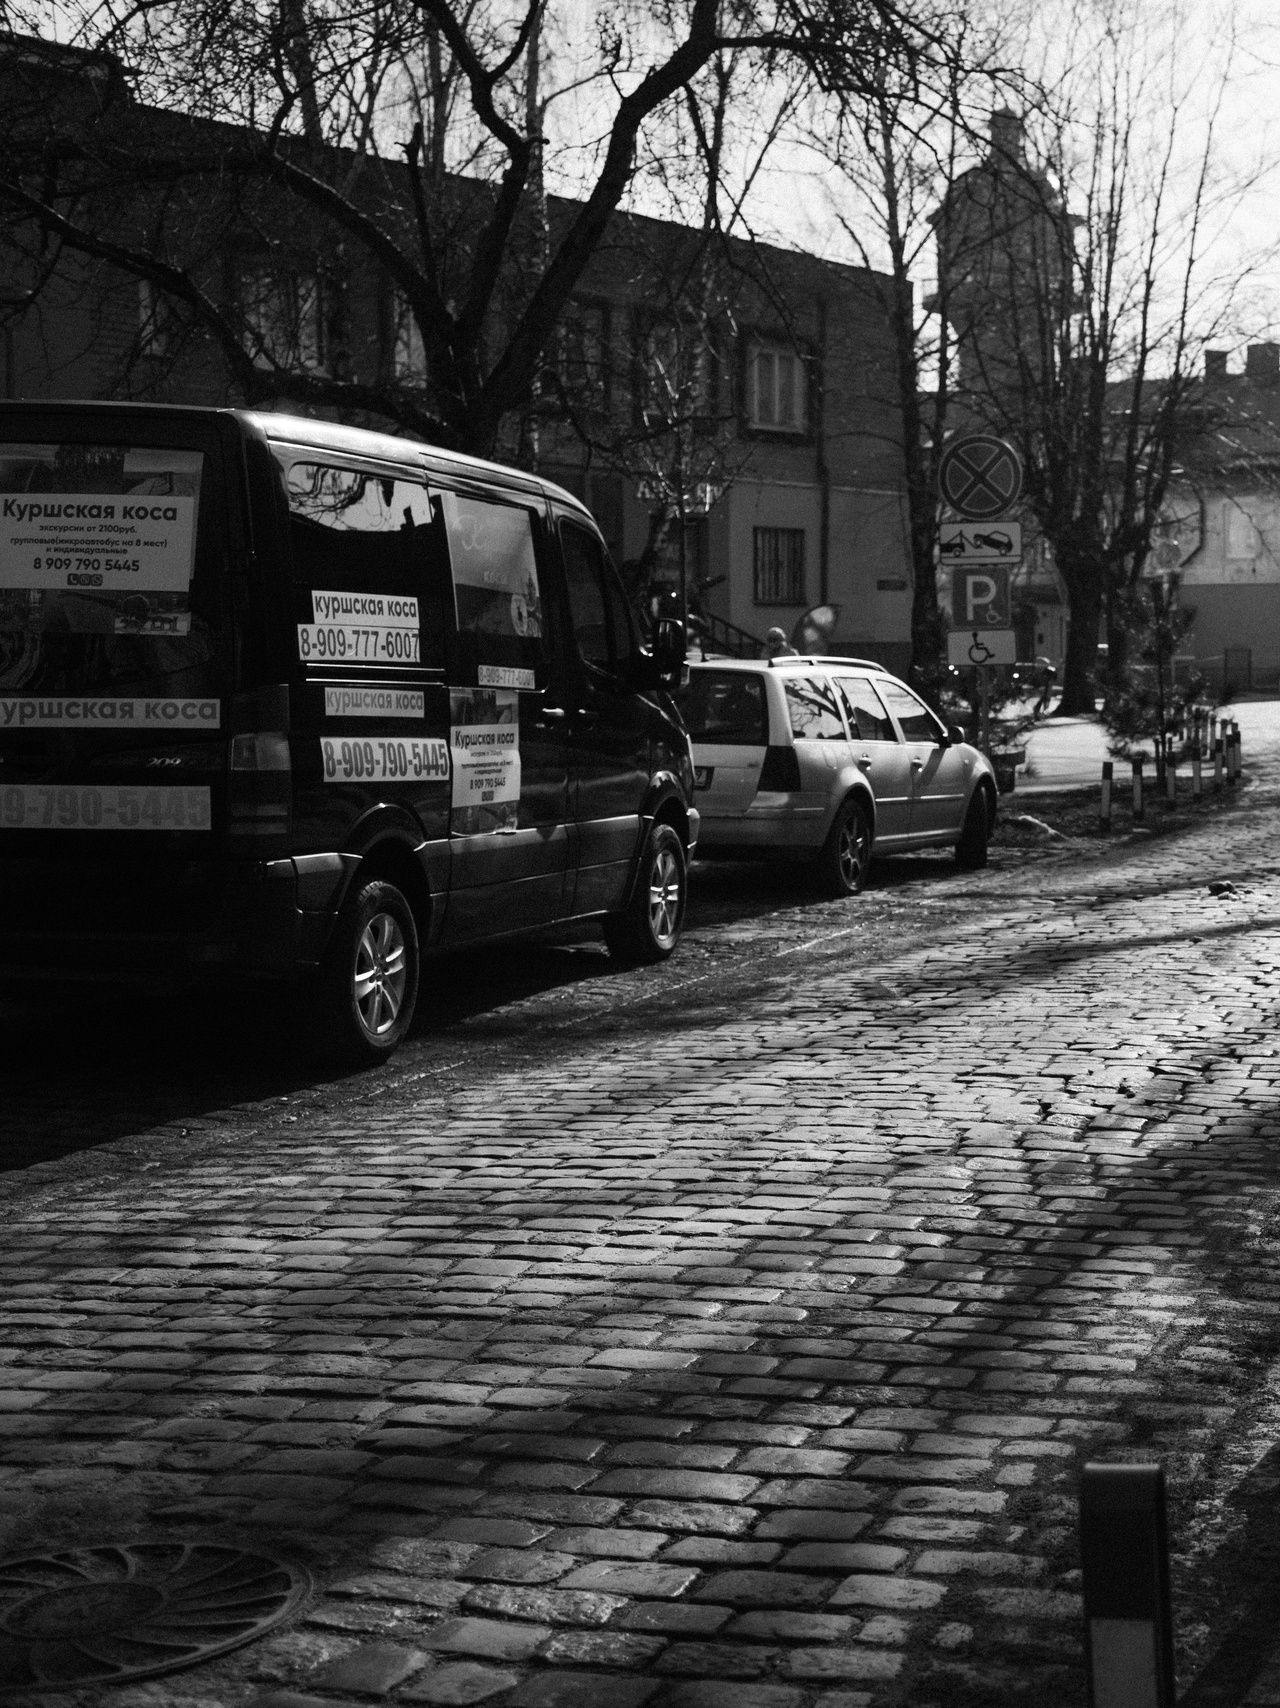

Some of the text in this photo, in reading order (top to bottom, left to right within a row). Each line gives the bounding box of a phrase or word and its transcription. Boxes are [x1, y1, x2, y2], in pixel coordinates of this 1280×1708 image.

[3, 499, 178, 522] Куршская коса
[39, 525, 84, 533] экскурсии
[53, 547, 128, 555] индивидуальные
[135, 539, 141, 547] 8
[33, 557, 140, 571] 8 909 790 5445
[314, 595, 417, 619] куршская коса
[966, 575, 997, 621] P
[301, 628, 419, 659] 8-909-777-6007
[0, 701, 218, 725] уршская коса
[326, 690, 423, 713] куршская коса
[455, 731, 514, 749] Куршская коса
[323, 741, 448, 778] 8-909-790-5445
[0, 787, 210, 827] 9-790-5445
